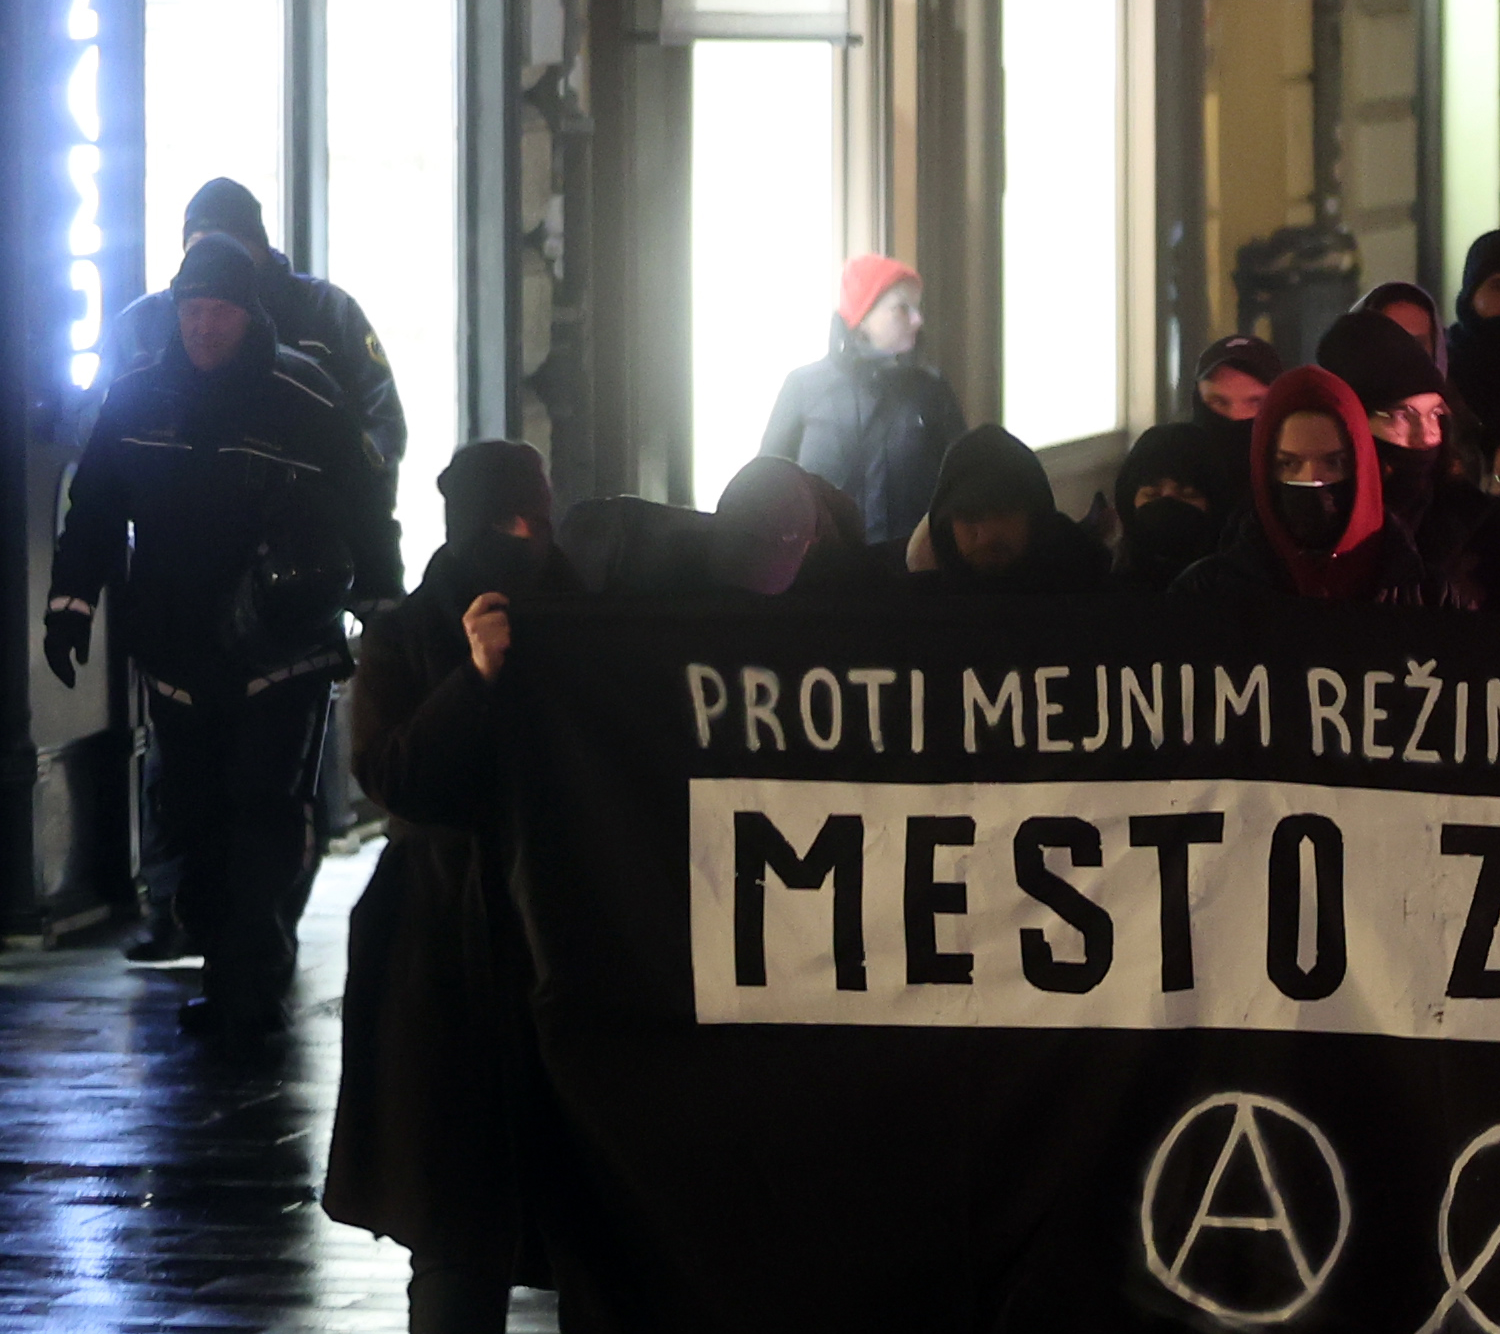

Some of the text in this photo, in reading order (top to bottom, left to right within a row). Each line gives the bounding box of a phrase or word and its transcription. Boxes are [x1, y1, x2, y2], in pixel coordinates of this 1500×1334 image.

[686, 661, 925, 754] PROTI
[962, 662, 1273, 754] MEJNIM
[732, 810, 1349, 1001] MESTO
